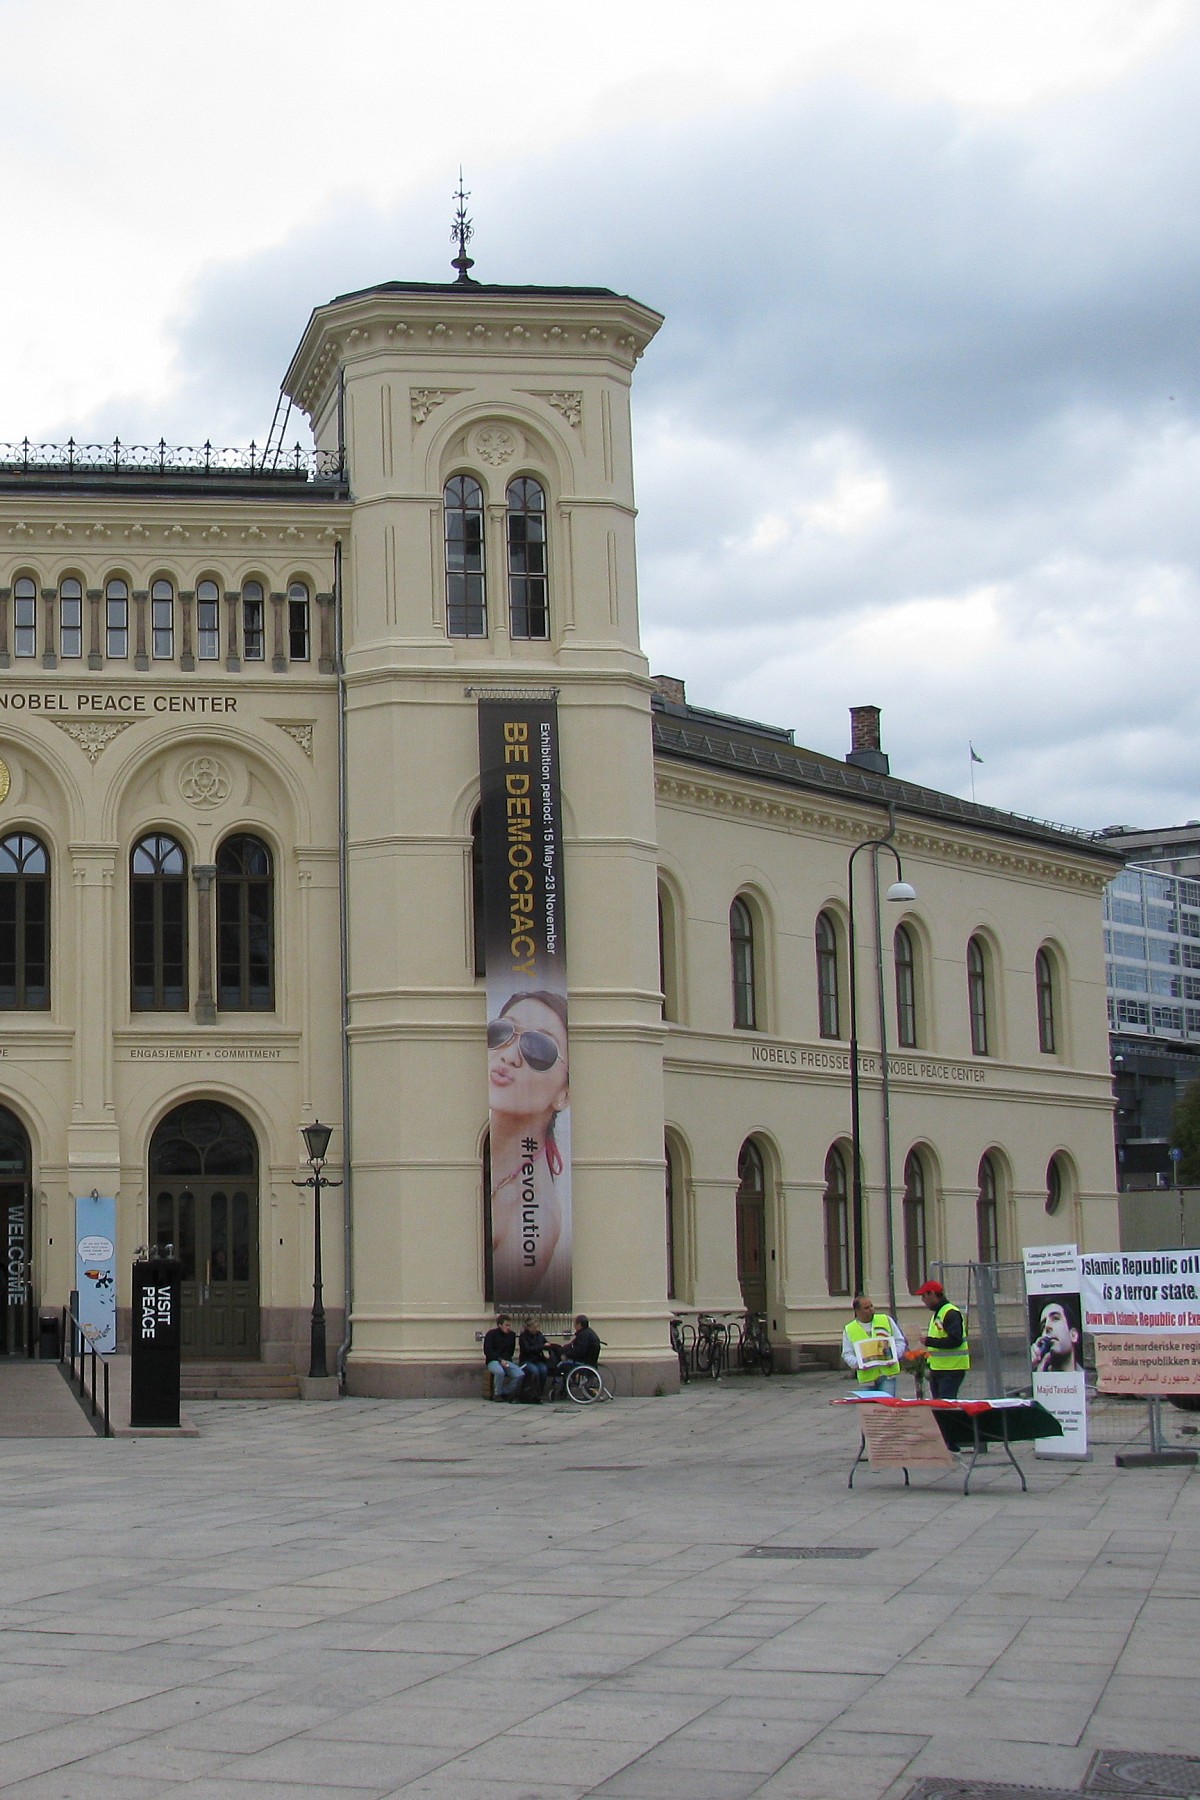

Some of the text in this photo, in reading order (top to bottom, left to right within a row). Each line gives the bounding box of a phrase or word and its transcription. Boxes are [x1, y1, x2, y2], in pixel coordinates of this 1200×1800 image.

[76, 694, 146, 712] PEACE
[153, 696, 237, 713] CENTER
[540, 723, 551, 780] Exhibition
[540, 783, 552, 825] period:
[543, 828, 554, 841] 15
[504, 722, 537, 977] BE DEMOCRACY
[545, 893, 557, 955] November
[130, 1049, 281, 1059] ENGASJEMENT COMMITMENT
[751, 1046, 797, 1065] NOBELS
[800, 1051, 876, 1073] FREDSSETER
[920, 1064, 949, 1080] PEACE
[951, 1066, 986, 1083] CENTER
[521, 1137, 539, 1268] #revolution
[7, 1205, 25, 1306] WELCOME
[1081, 1257, 1121, 1276] Islamic
[1122, 1256, 1178, 1277] Republic
[1180, 1256, 1192, 1274] of
[157, 1286, 171, 1325] VISIT
[1103, 1282, 1199, 1301] is a terror state.
[141, 1286, 156, 1339] PEACE
[1085, 1310, 1103, 1325] Down
[1116, 1310, 1138, 1327] Islamic
[1139, 1311, 1176, 1328] Republic
[1177, 1311, 1187, 1327] of
[1123, 1341, 1134, 1352] det
[1140, 1356, 1190, 1368] republikken
[1037, 1385, 1054, 1397] Majid
